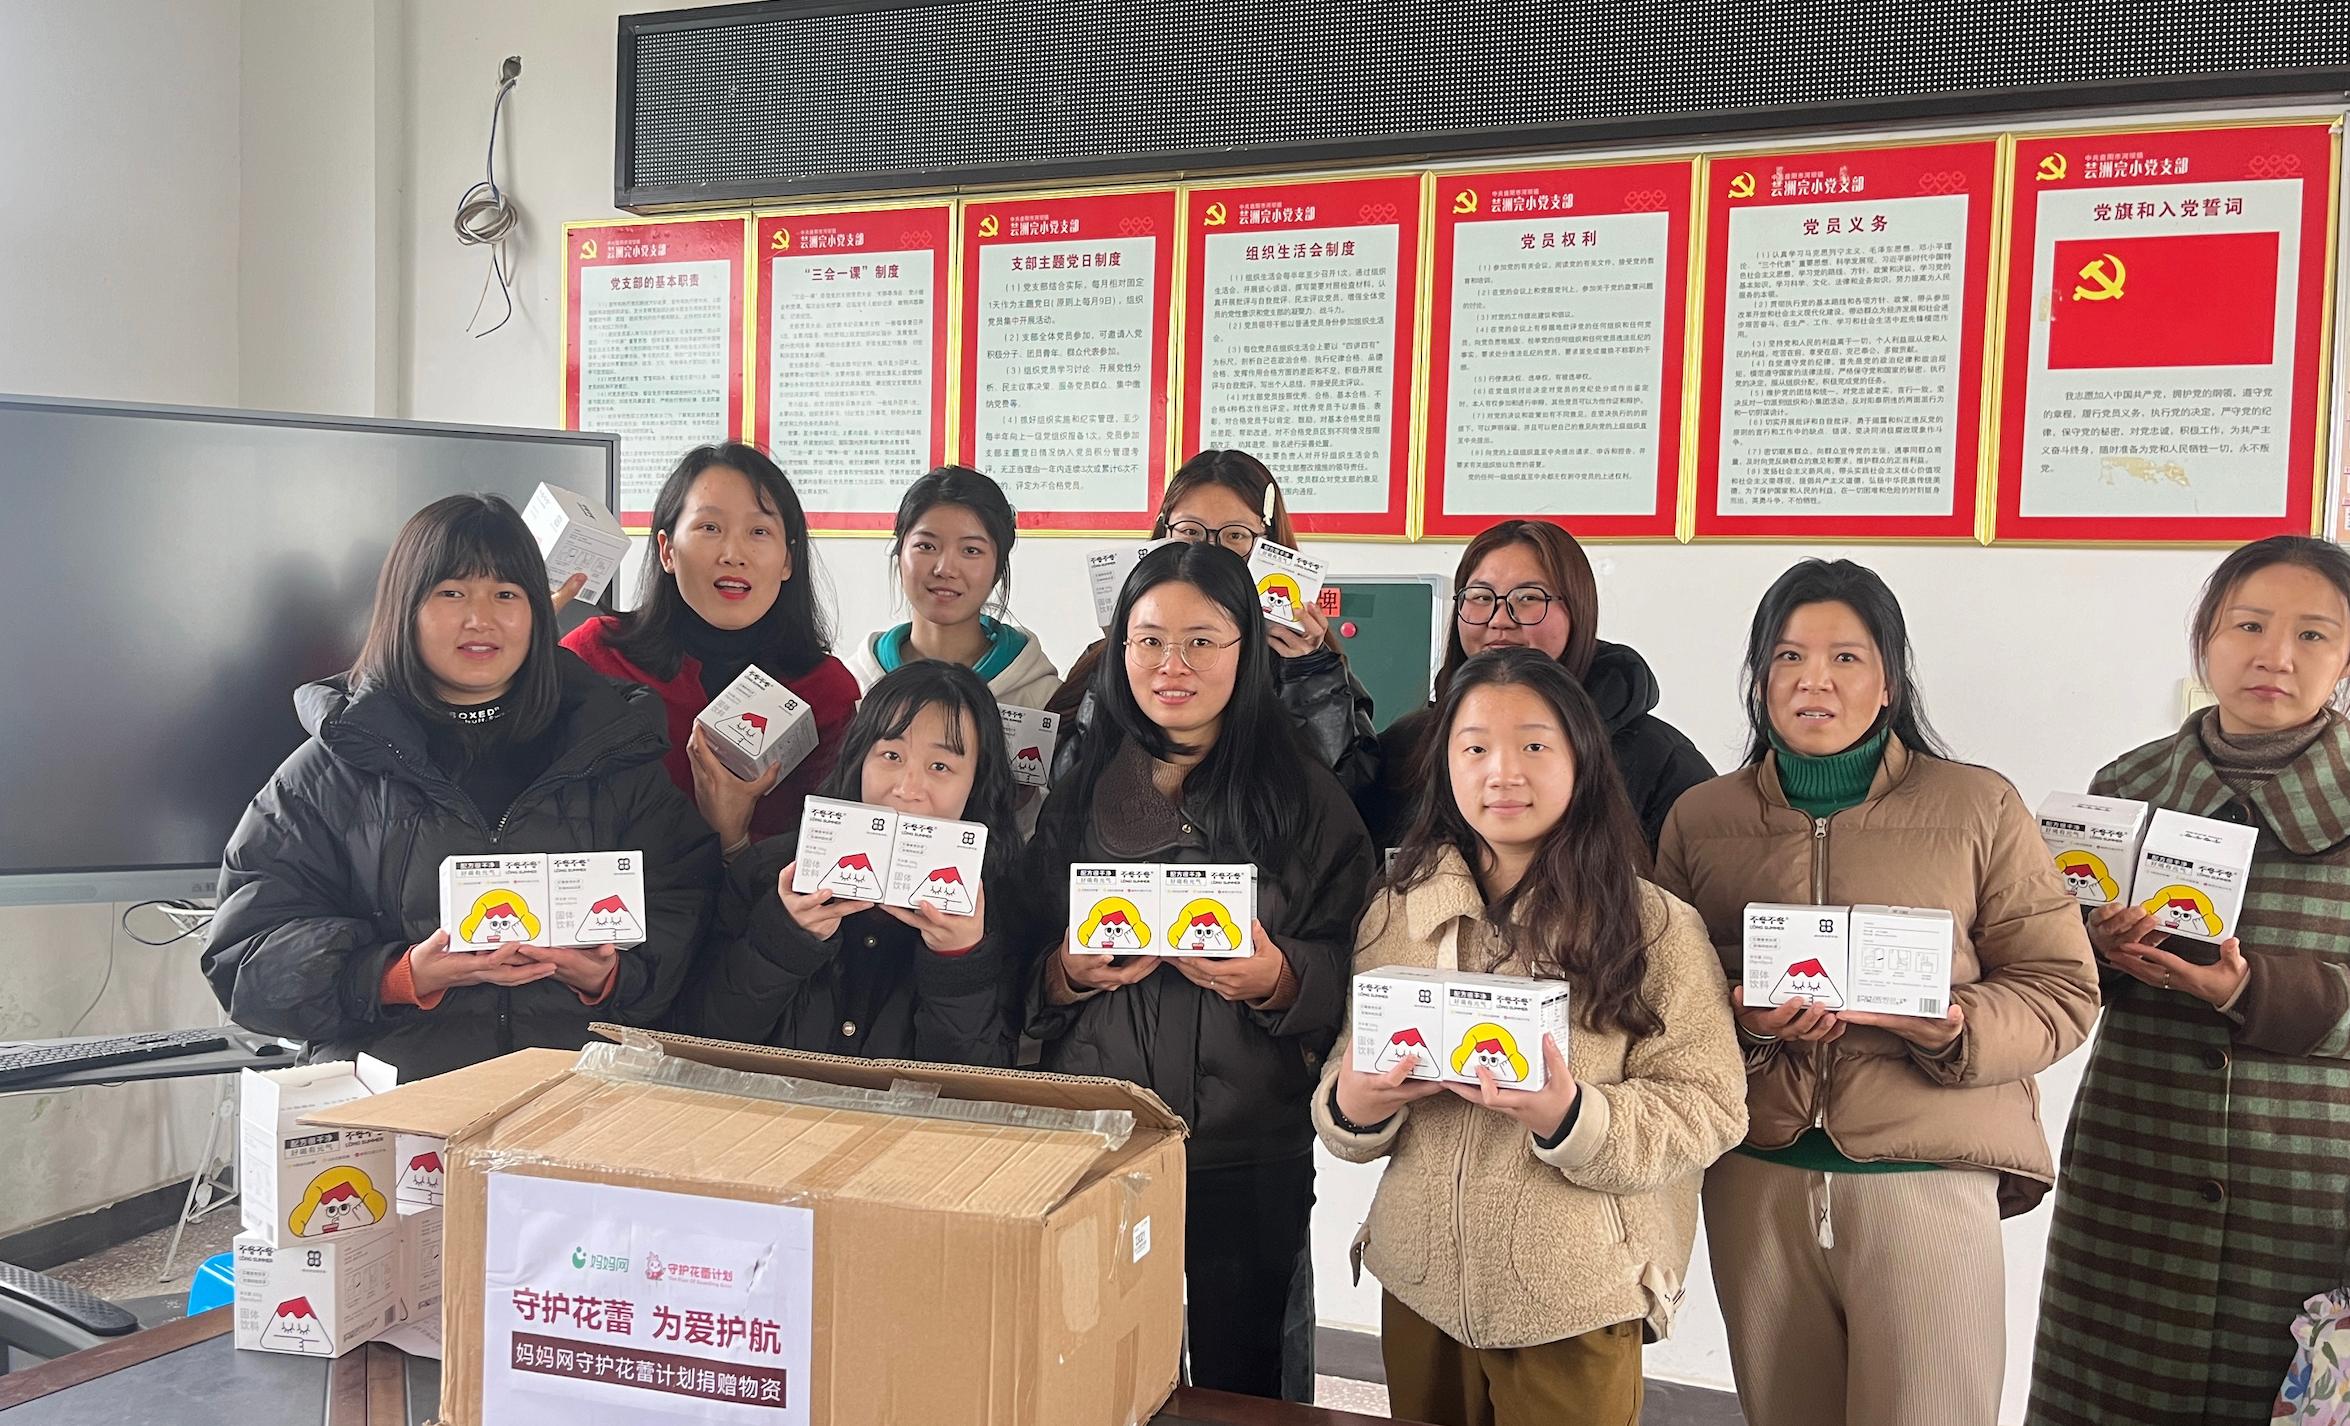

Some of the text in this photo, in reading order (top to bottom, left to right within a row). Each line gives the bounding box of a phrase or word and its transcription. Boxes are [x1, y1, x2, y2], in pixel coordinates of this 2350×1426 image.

[2092, 196, 2243, 221] 党旗和入党誓词
[1801, 214, 1888, 236] 党员义务
[1245, 239, 1355, 261] 组织生活会制度
[1519, 229, 1597, 250] 党员权利
[1010, 251, 1123, 271] 支部主题党日制度
[610, 272, 700, 292] 党支部的基本职责
[590, 1254, 630, 1273] 妈妈网
[668, 1263, 733, 1282] 守护花蕾计划
[512, 1287, 782, 1355] 守护花蕾 为爱护航
[515, 1341, 782, 1402] 妈妈网守护花蕾计划捐赠物资
